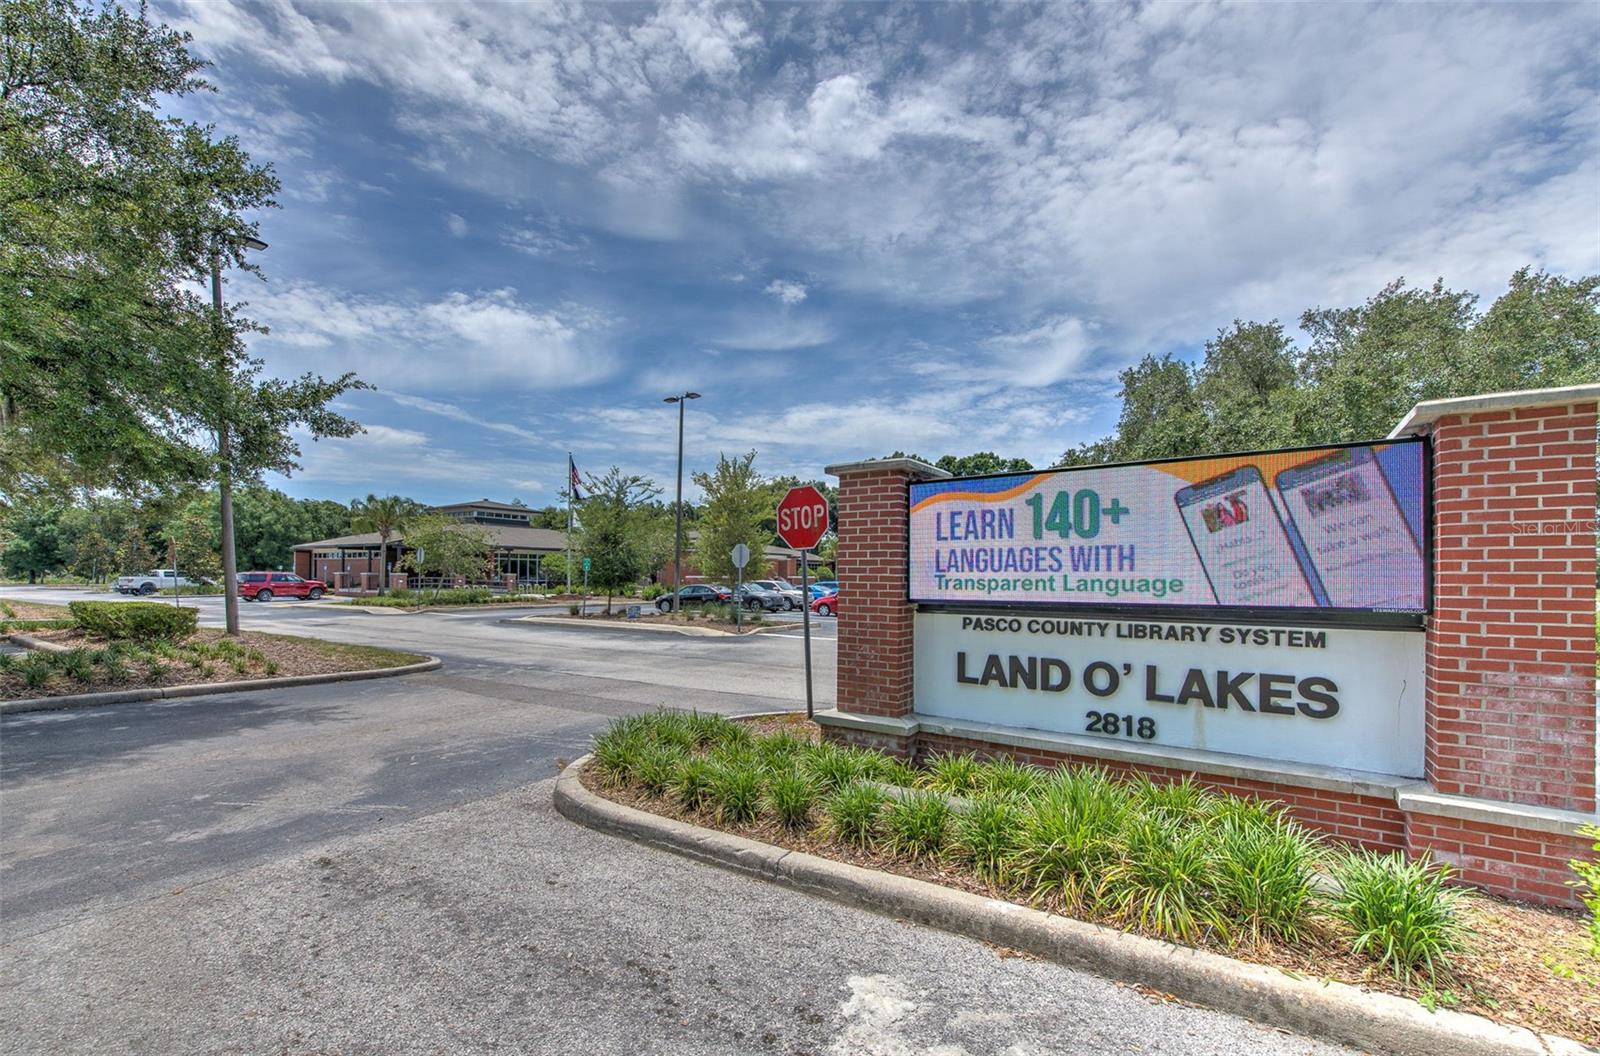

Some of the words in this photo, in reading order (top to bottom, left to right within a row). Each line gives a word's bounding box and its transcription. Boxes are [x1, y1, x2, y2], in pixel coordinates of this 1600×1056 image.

[781, 504, 825, 531] STOP
[936, 508, 1014, 541] LEARN
[1025, 489, 1130, 540] 140+
[935, 546, 1063, 573] LANGUAGES
[1069, 544, 1136, 572] WITH
[934, 574, 1056, 594] Transparent
[1063, 574, 1184, 597] Language
[962, 616, 1022, 633] PASCO
[1027, 620, 1109, 637] COUNTY
[1116, 623, 1212, 642] LIBRARY
[1219, 627, 1326, 648] SYSTEM
[957, 651, 1072, 692] LAND
[1083, 661, 1132, 697] O'
[1146, 665, 1341, 719] LAKES
[1085, 710, 1157, 739] 2818
